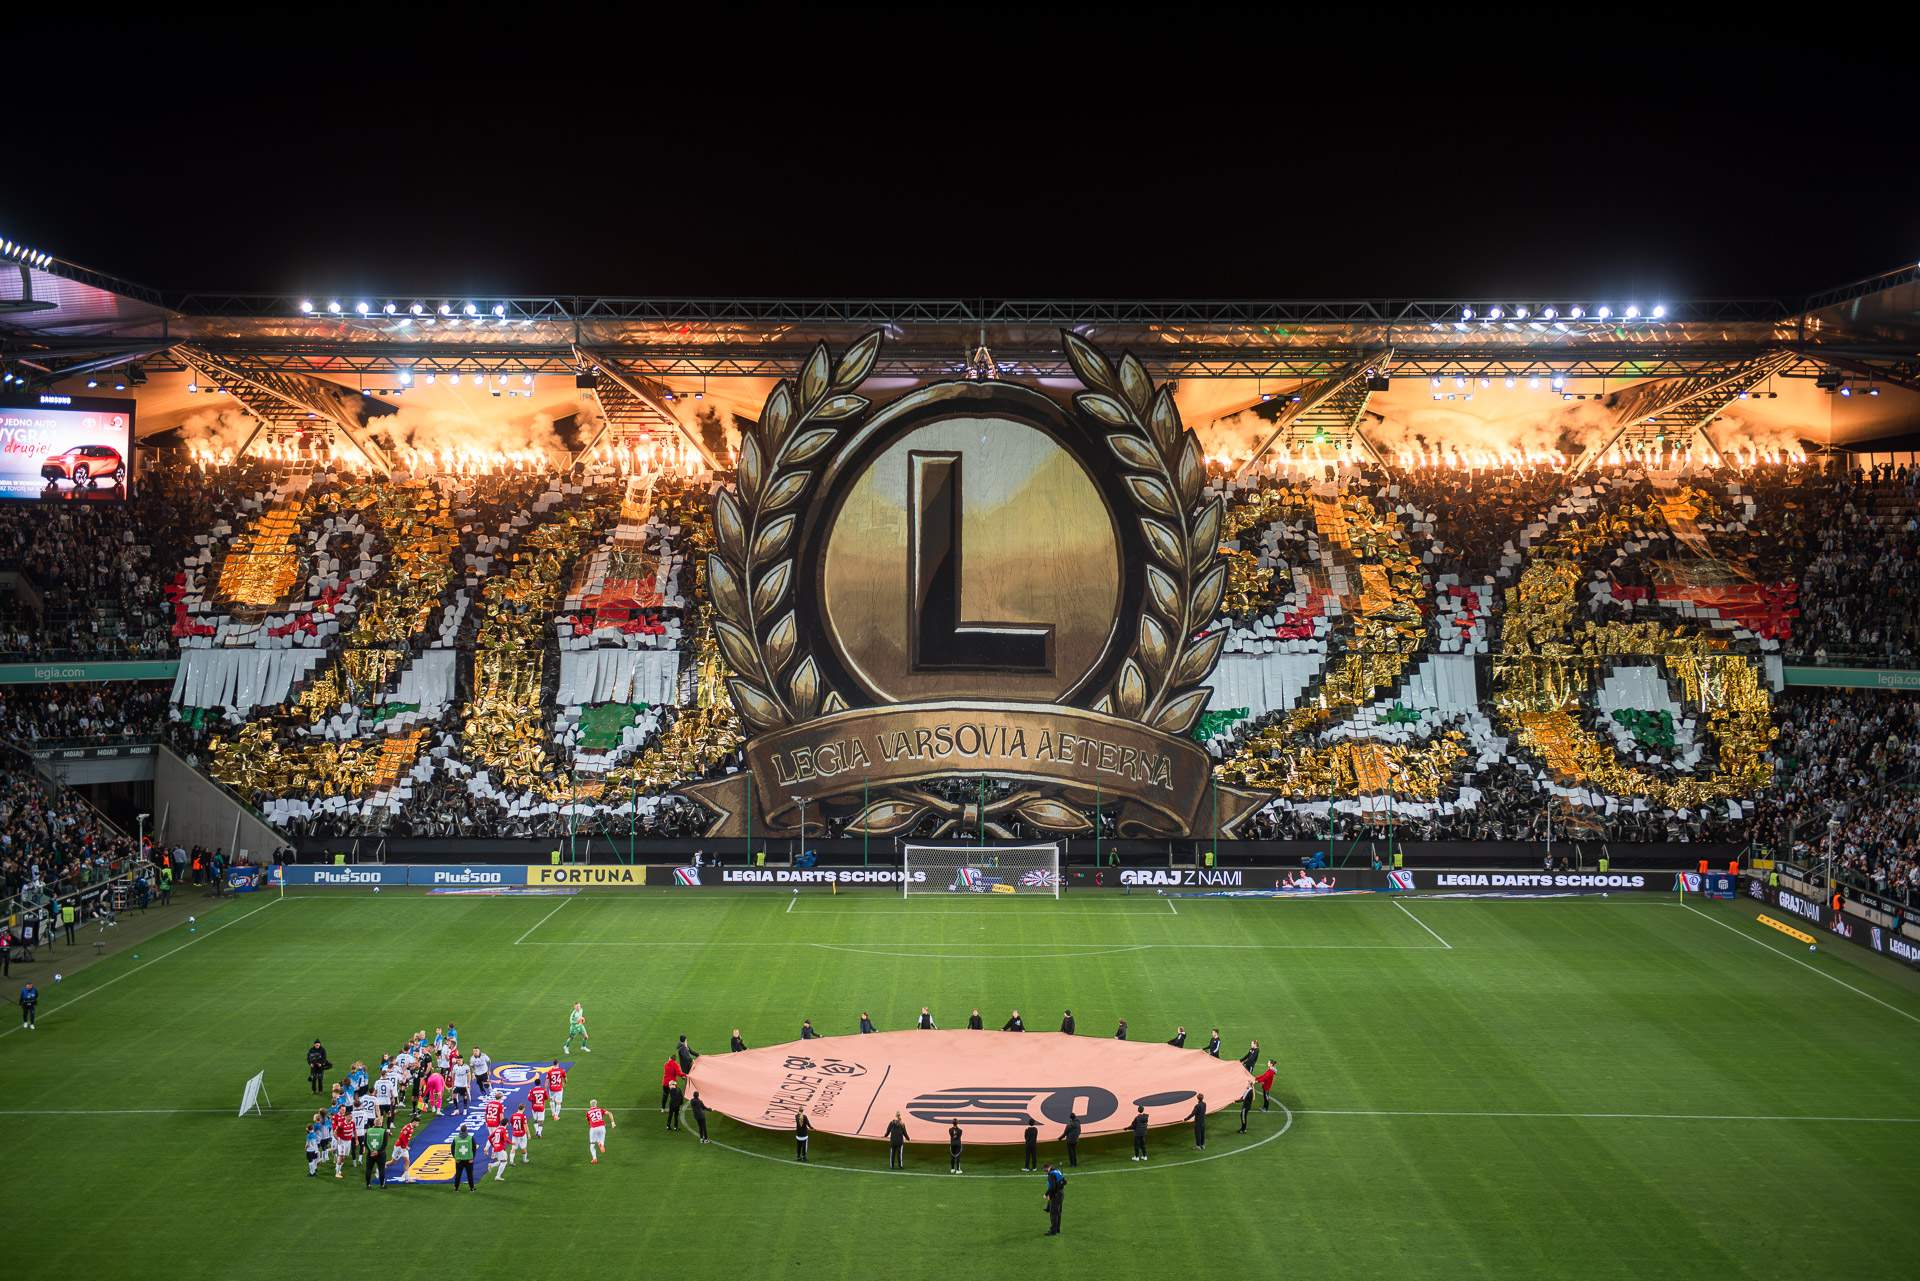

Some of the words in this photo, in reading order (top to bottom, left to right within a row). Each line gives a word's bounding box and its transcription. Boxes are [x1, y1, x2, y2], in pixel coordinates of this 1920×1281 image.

[4, 418, 32, 427] JEDNO
[908, 449, 1056, 676] L
[34, 667, 85, 680] legia.com
[771, 739, 871, 787] LEGIA
[876, 723, 1029, 762] VARSOVIA
[1034, 726, 1175, 791] AETERNA
[314, 869, 381, 883] Plus500
[434, 869, 501, 883] Plus500
[540, 868, 634, 883] FORTUNA
[723, 870, 774, 882] LEGIA
[777, 871, 837, 882] DARTS
[839, 871, 927, 883] SCHOOLS
[1120, 870, 1182, 885] GRAJ
[1184, 870, 1196, 885] Z
[1198, 870, 1242, 885] NAMI
[1437, 874, 1489, 886] LEGIA
[1491, 875, 1552, 886] DARTS
[1555, 875, 1645, 887] SCHOOLS
[1779, 891, 1800, 913] GRAJ
[1799, 899, 1804, 915] Z
[1889, 938, 1911, 959] LEGIA
[551, 1075, 562, 1084] 34
[380, 1084, 387, 1095] 9
[535, 1094, 544, 1104] 12
[363, 1101, 375, 1111] 22
[487, 1107, 498, 1118] 52
[355, 1115, 364, 1126] 17
